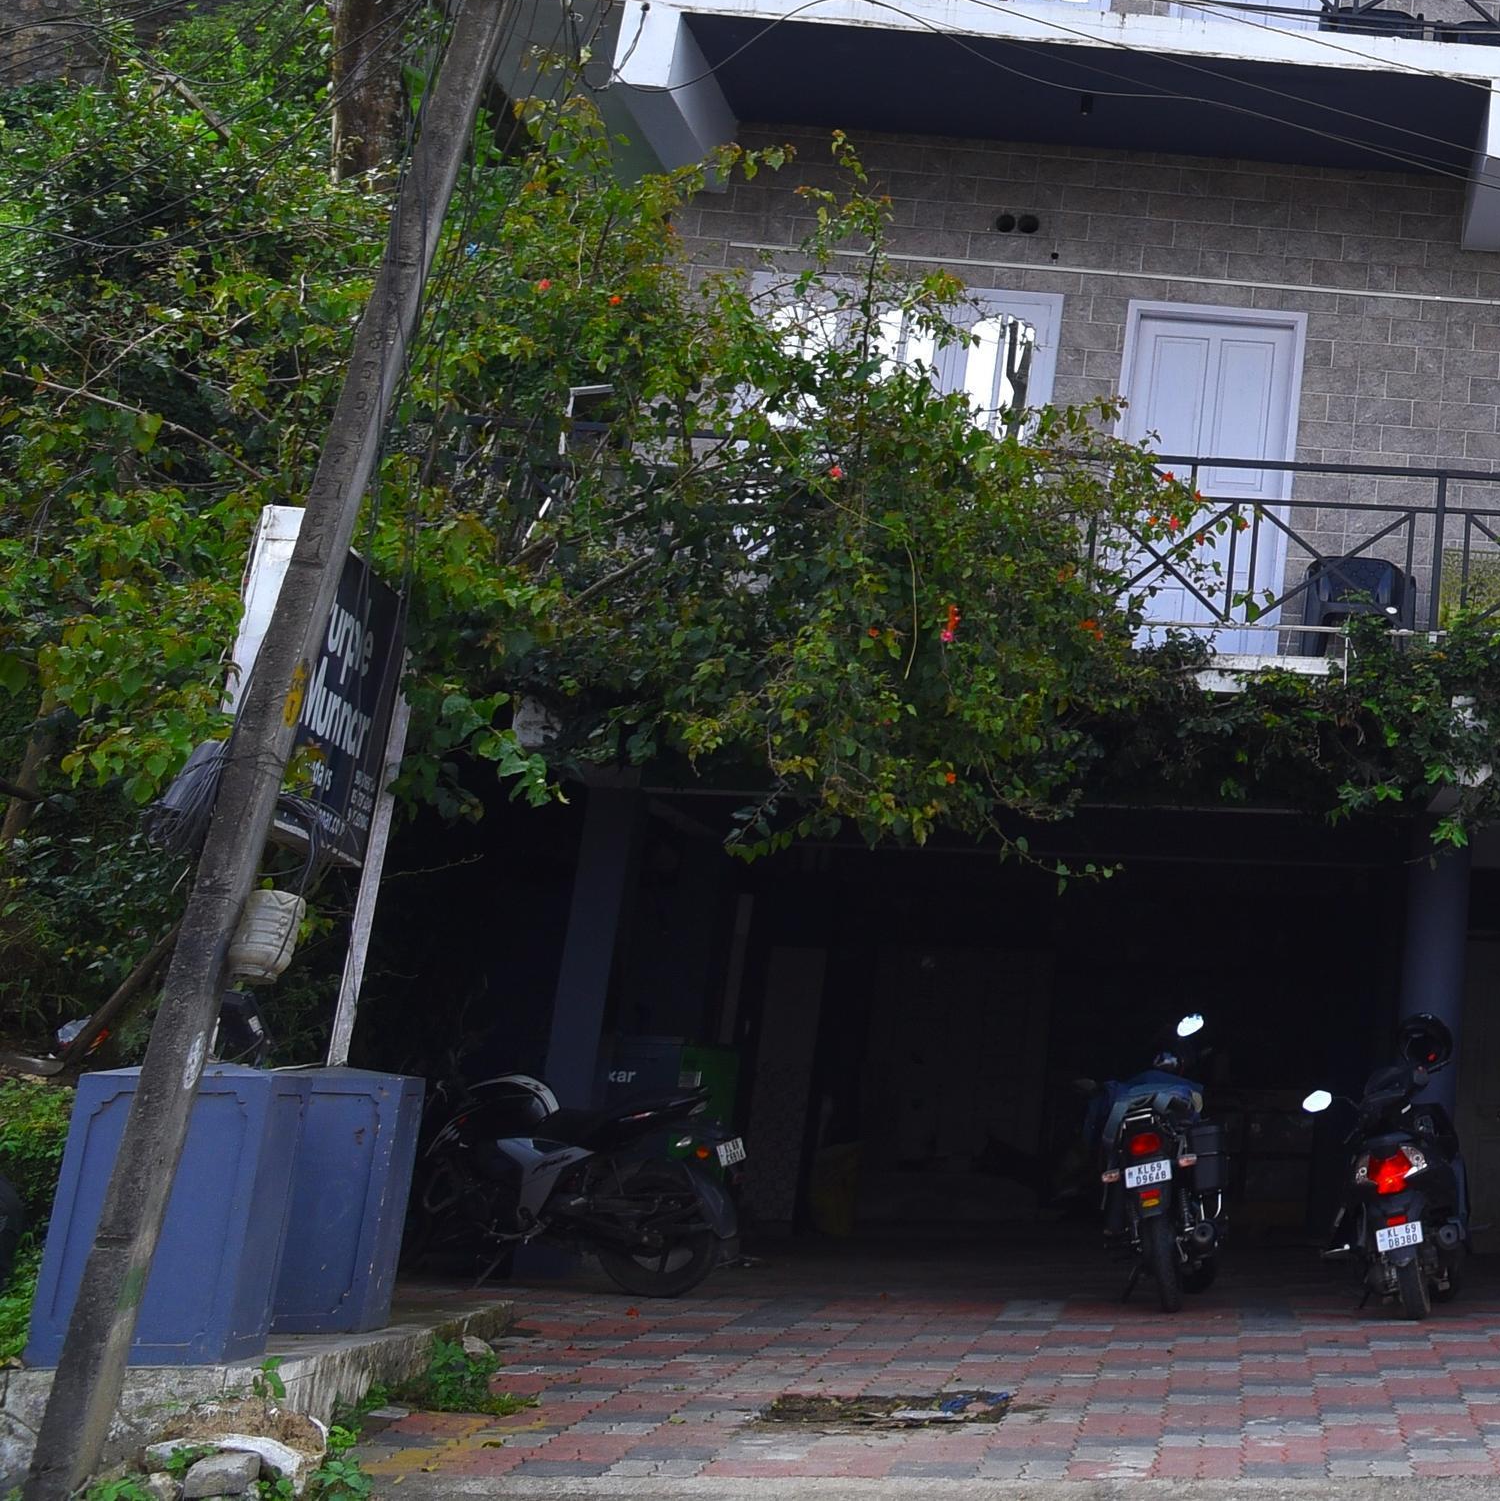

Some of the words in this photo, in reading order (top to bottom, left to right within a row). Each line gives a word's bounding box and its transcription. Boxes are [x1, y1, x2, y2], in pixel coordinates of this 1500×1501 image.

[328, 593, 375, 685] urple
[1387, 1228, 1398, 1238] KL
[1405, 1224, 1417, 1234] 69
